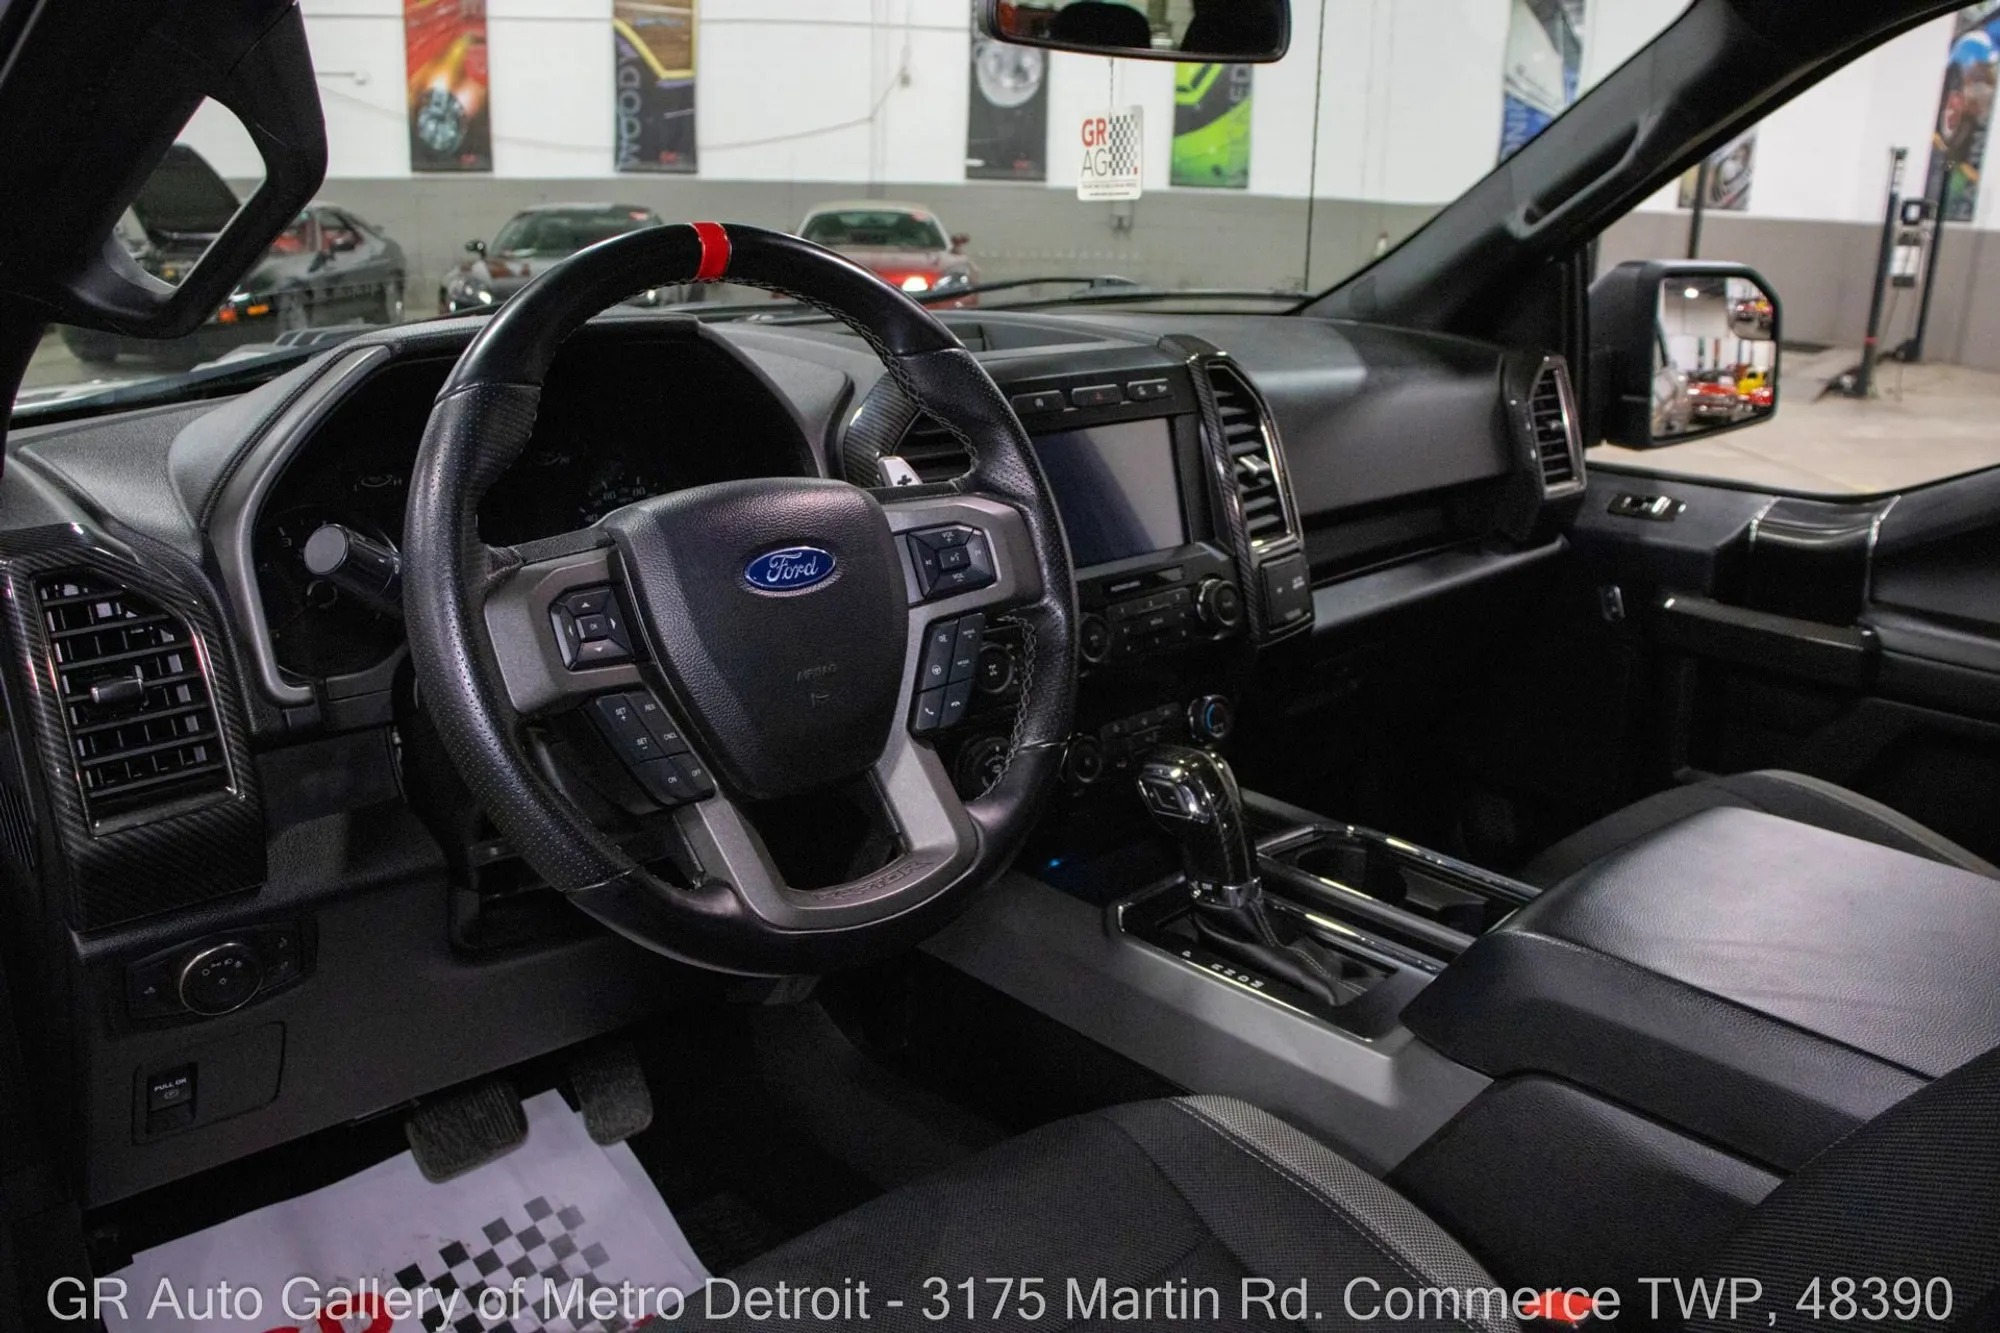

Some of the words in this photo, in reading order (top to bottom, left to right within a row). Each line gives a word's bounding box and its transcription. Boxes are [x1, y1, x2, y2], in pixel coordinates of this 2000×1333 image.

[1081, 117, 1107, 147] GR
[1081, 148, 1108, 176] AG
[766, 552, 818, 582] Ford
[154, 1081, 174, 1092] PULL
[175, 1077, 187, 1085] ON
